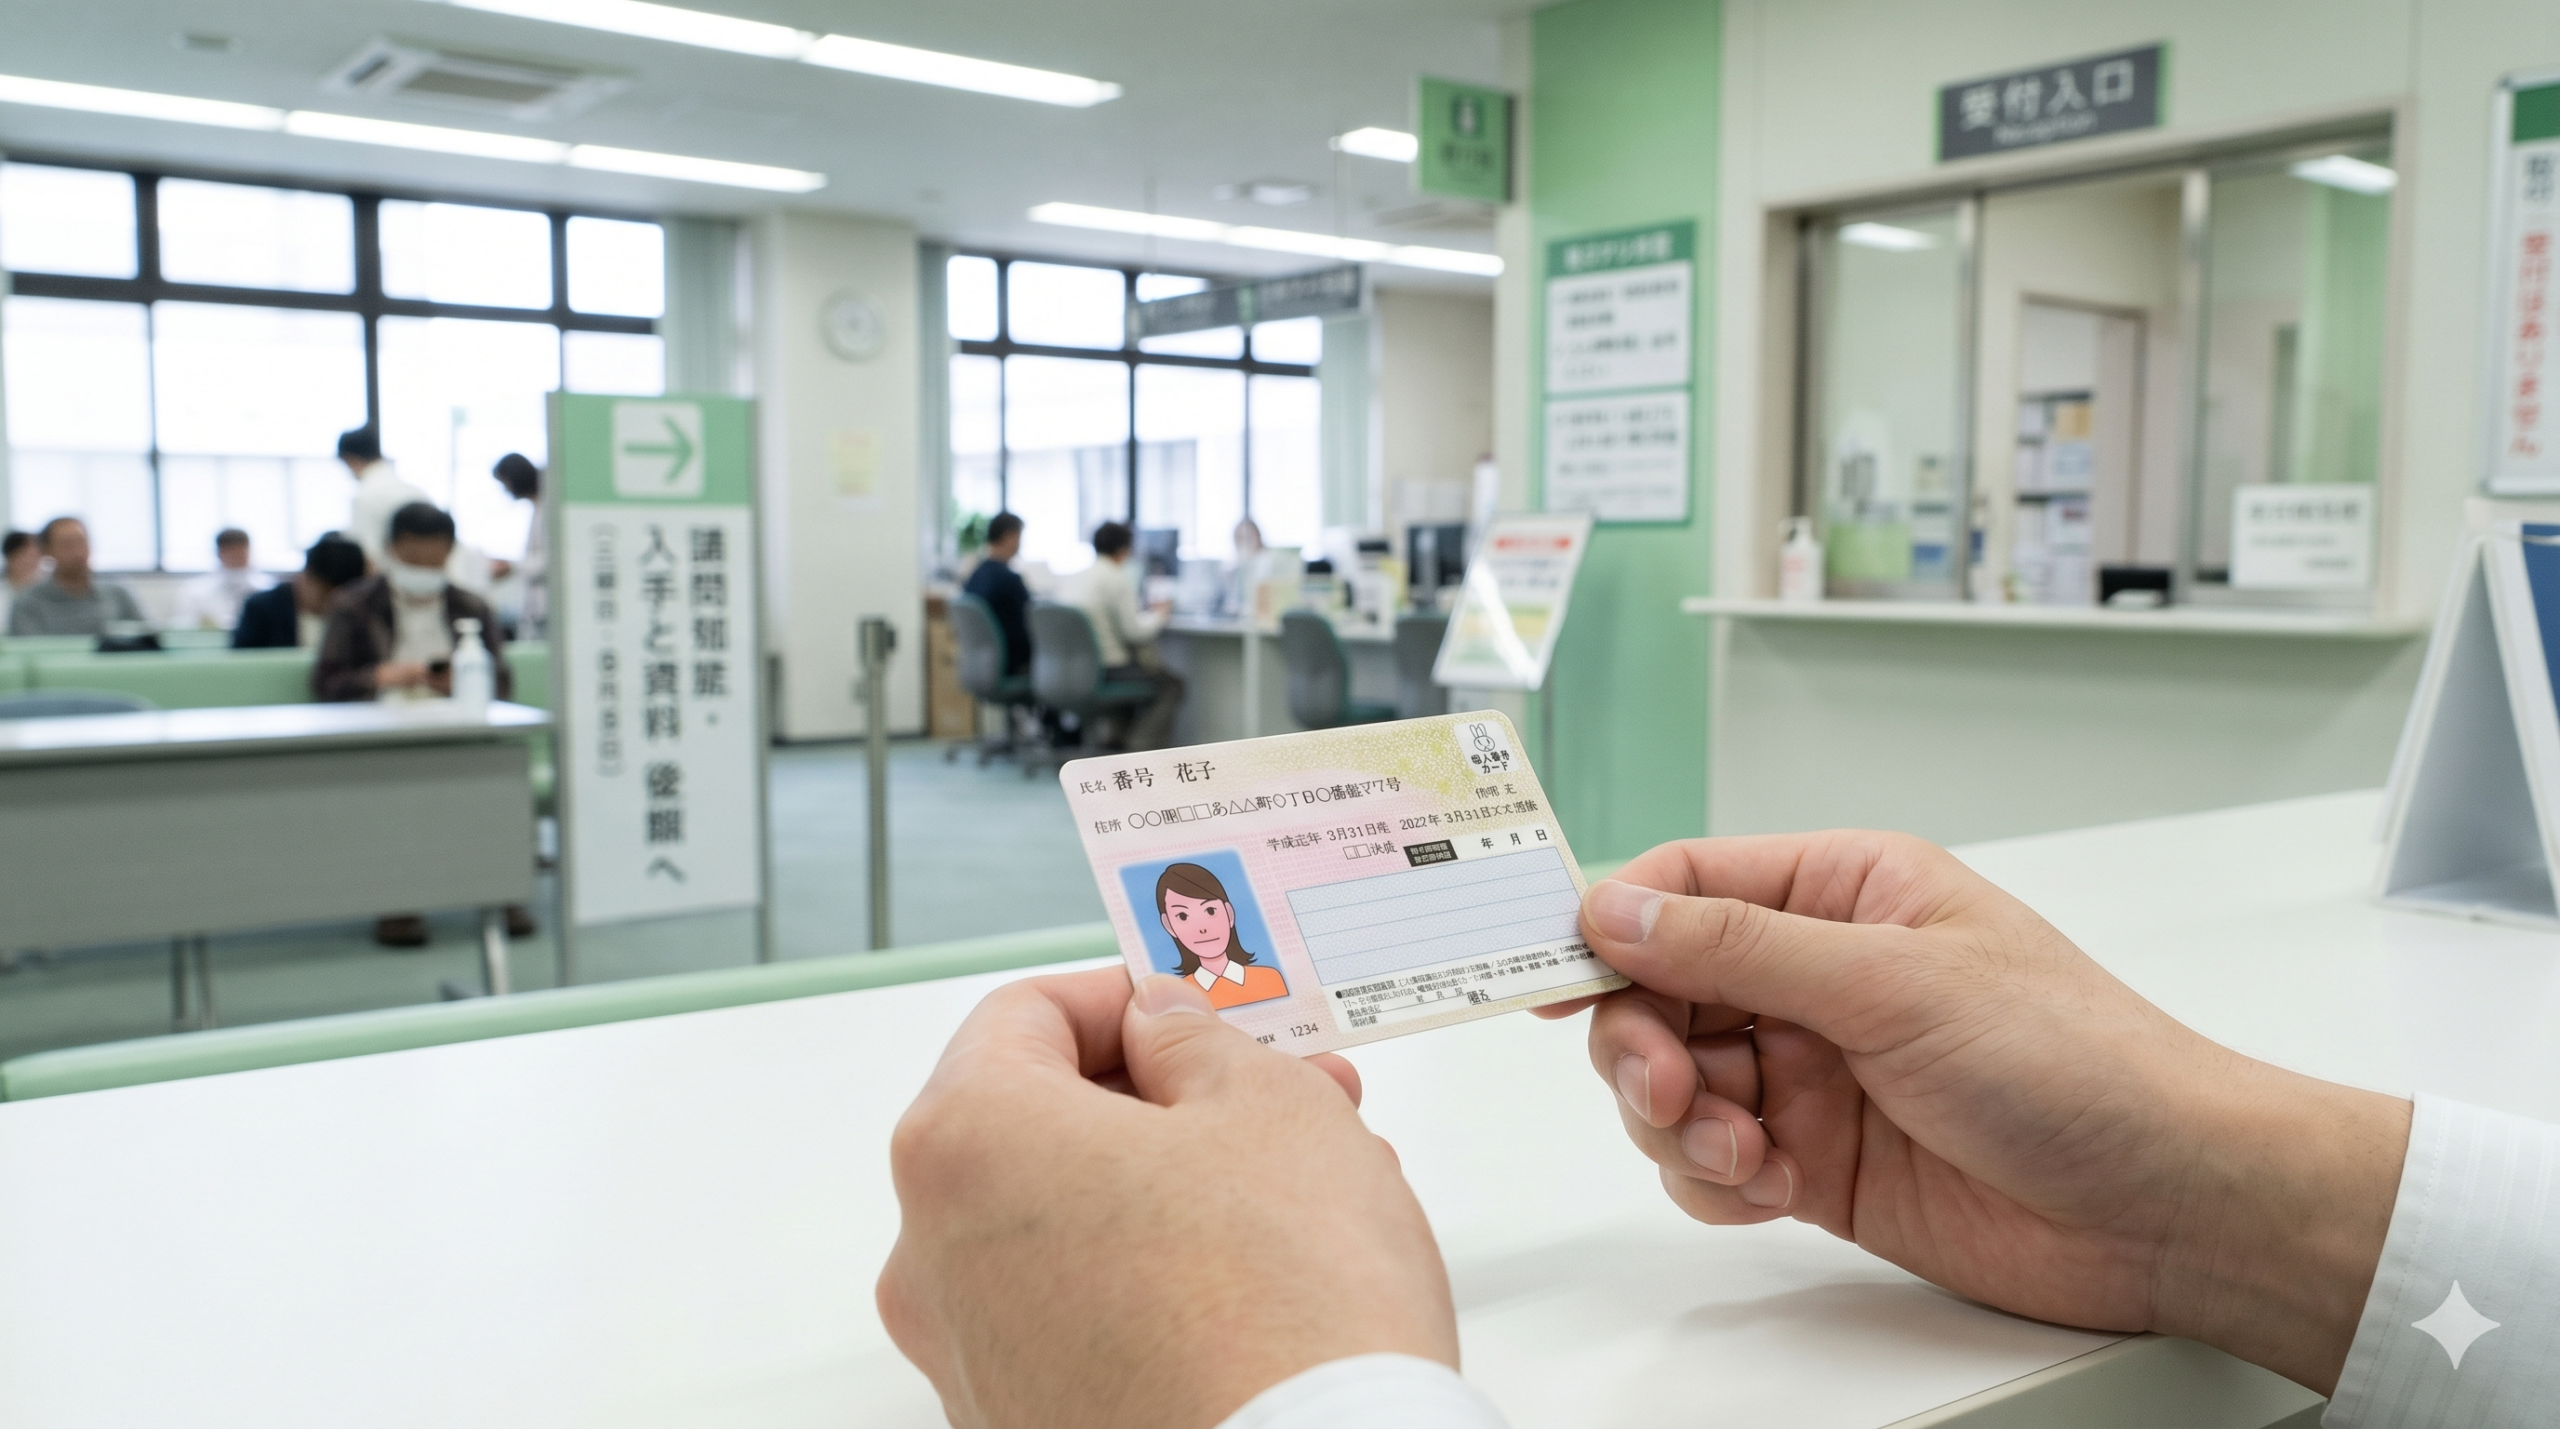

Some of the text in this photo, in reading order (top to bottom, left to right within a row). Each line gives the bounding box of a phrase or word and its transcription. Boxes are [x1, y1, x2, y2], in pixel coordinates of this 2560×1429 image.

[1959, 58, 2135, 131] 受付入口
[1080, 760, 1216, 794] 氏名 番号 花子
[1482, 761, 1508, 774] カード
[1481, 829, 1548, 849] 年 月 日
[1290, 1023, 1319, 1038] 1234
